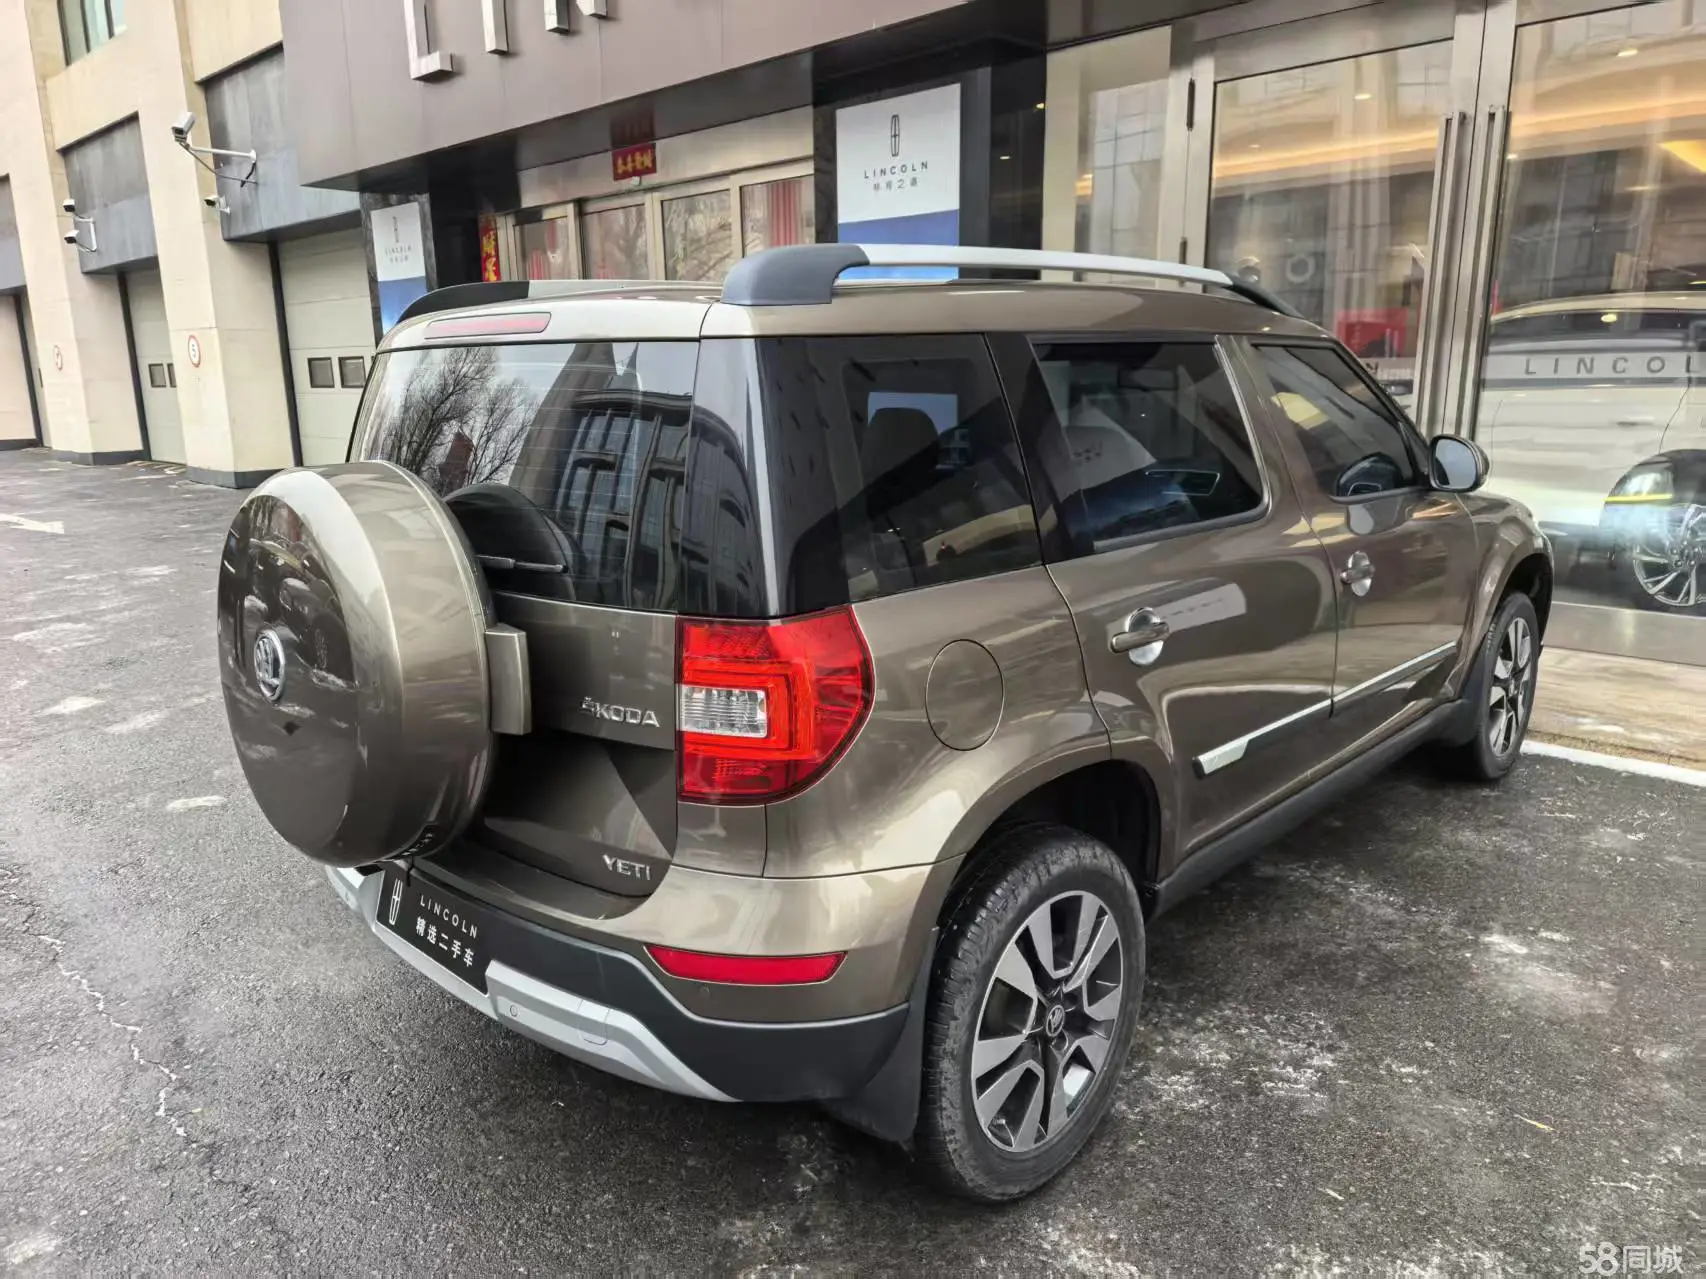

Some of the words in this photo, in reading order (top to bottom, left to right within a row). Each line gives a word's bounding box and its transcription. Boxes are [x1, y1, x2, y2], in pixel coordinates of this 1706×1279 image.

[863, 160, 929, 179] LINCOLN
[602, 854, 650, 880] YETI
[420, 893, 478, 939] LINCOLN
[415, 916, 474, 967] 精选二手车
